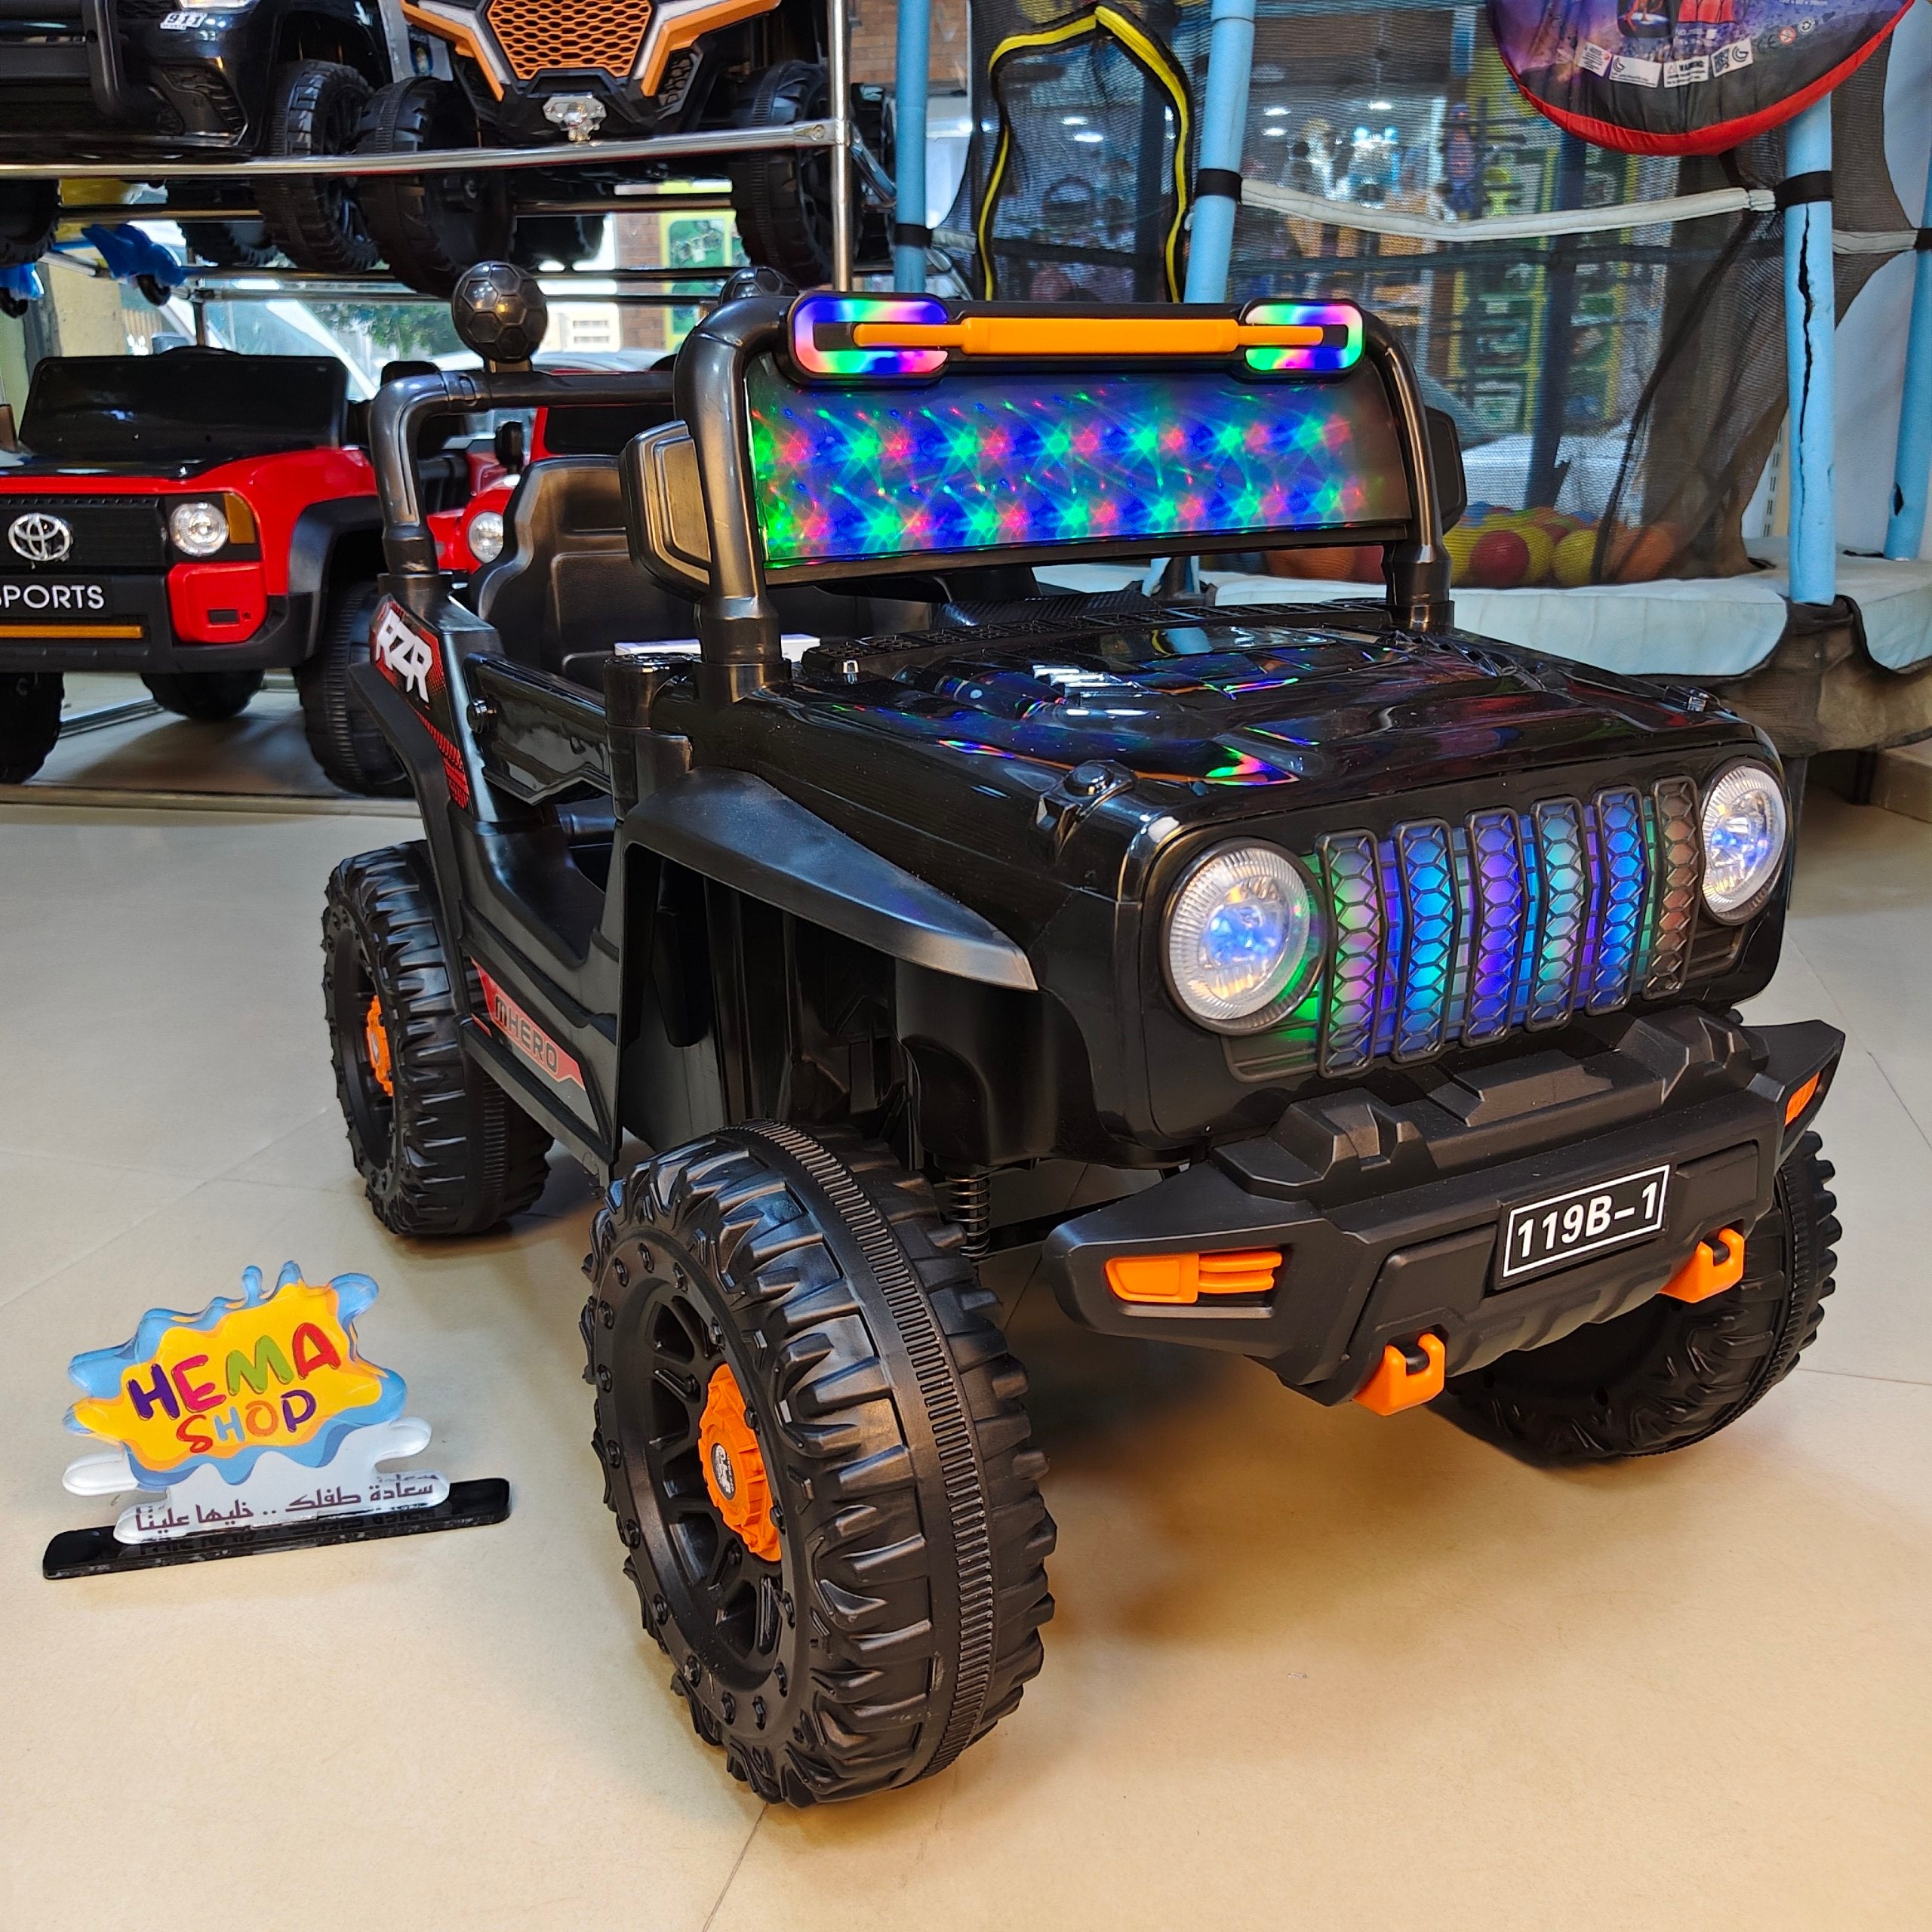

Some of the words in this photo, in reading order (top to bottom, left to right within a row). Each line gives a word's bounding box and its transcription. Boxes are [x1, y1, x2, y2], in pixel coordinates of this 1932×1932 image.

[167, 14, 202, 25] 911
[0, 584, 105, 610] PORTS
[375, 608, 433, 703] RZR
[1517, 1181, 1658, 1259] 119B-1
[127, 1322, 341, 1420] HEMA
[176, 1389, 317, 1454] SHOP
[285, 1485, 362, 1512] طفلك
[368, 1482, 434, 1502] سعادة
[135, 1507, 190, 1534] علينا
[195, 1499, 254, 1525] خليها
